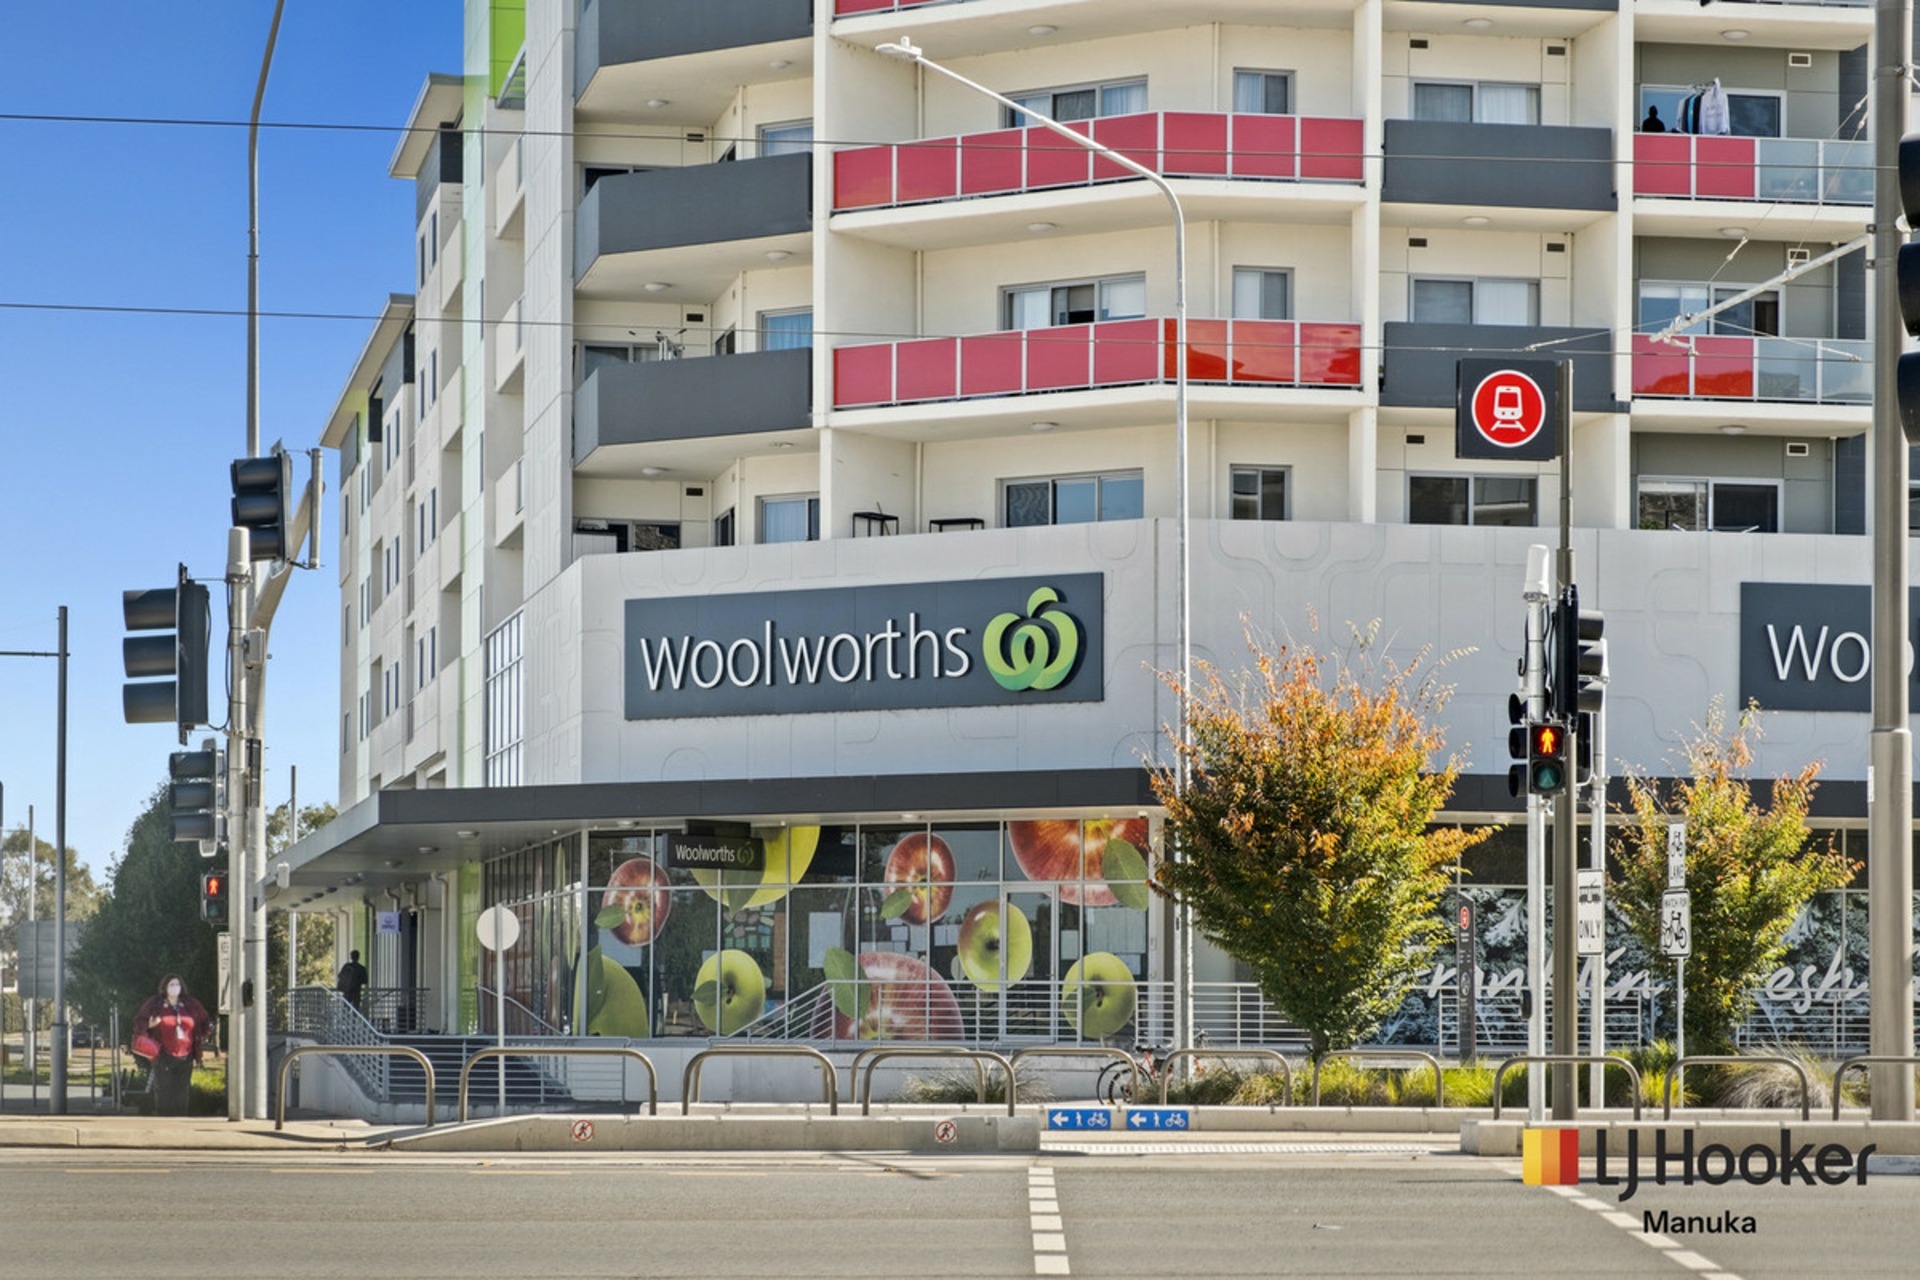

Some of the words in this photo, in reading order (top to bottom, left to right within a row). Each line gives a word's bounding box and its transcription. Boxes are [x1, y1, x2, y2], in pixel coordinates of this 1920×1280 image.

[640, 612, 971, 690] Woolworths
[675, 844, 735, 861] Woolworths
[1578, 919, 1602, 938] ONLY
